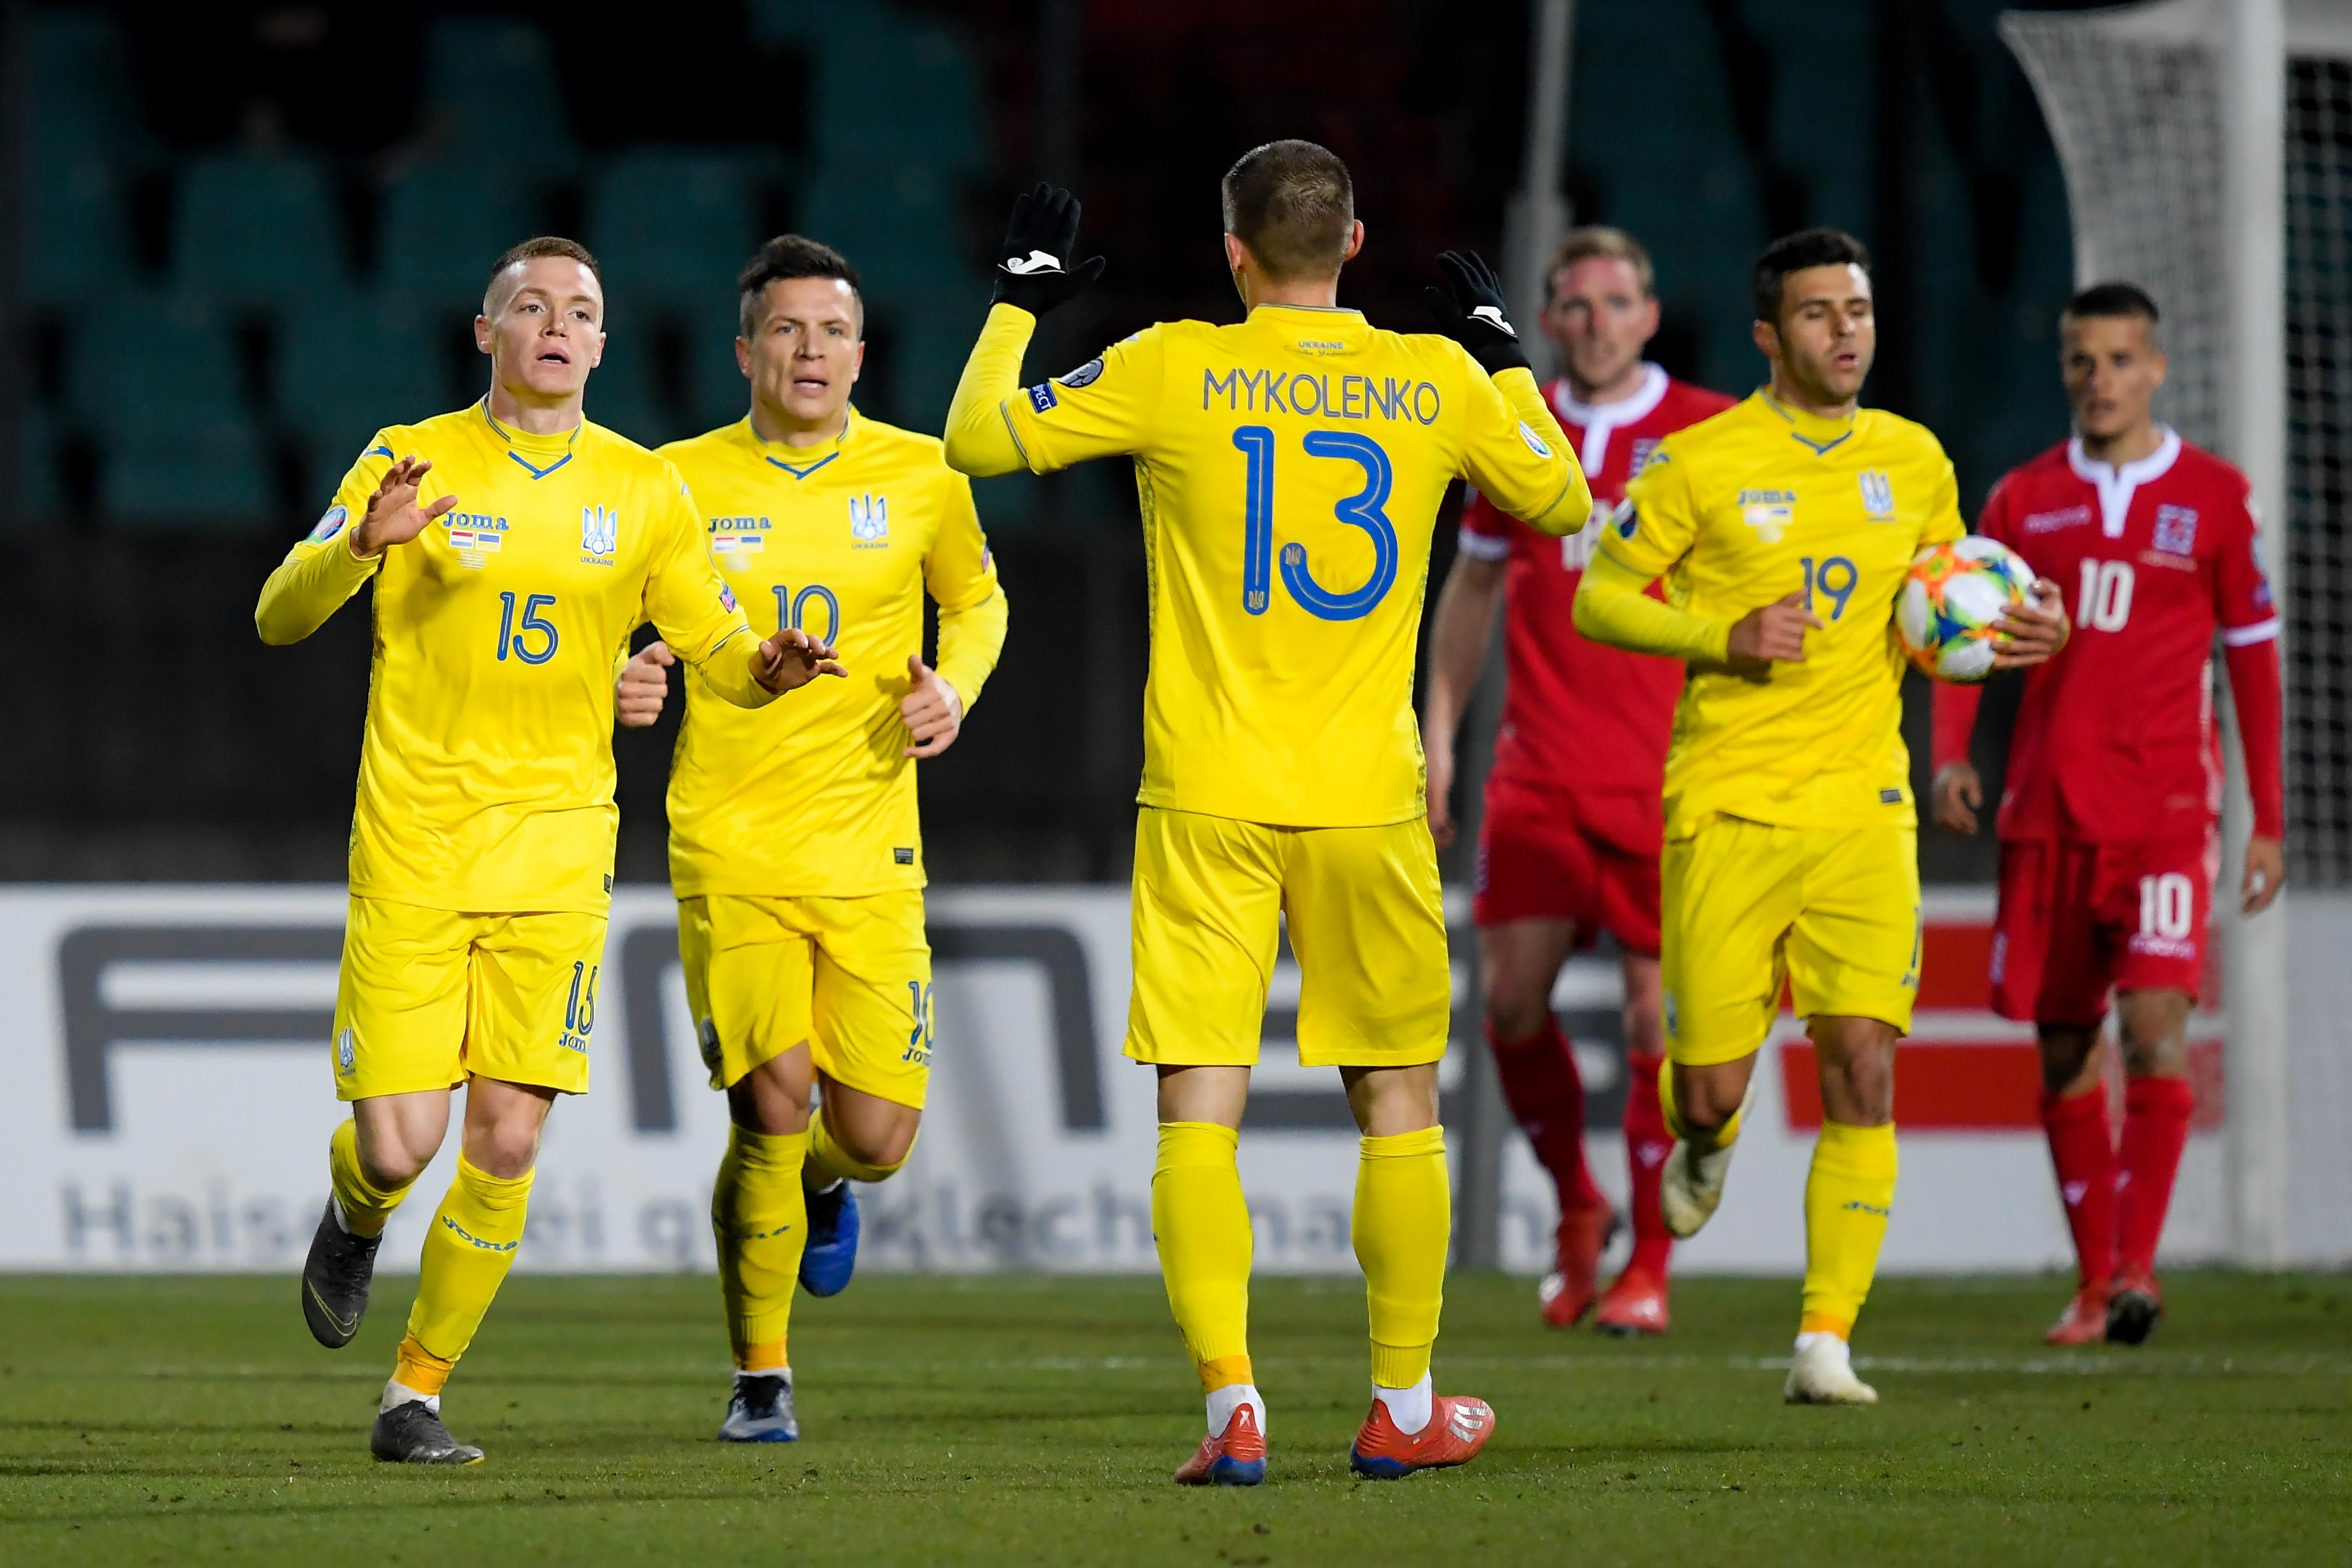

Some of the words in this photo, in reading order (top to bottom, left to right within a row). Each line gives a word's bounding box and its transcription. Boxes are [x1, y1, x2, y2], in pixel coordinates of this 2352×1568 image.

[1297, 340, 1344, 350] UKRAINE
[1031, 383, 1052, 410] PECT
[1203, 368, 1440, 426] MYKOLENKO
[443, 512, 509, 531] Joma
[708, 516, 772, 533] Joma
[1232, 425, 1399, 621] 13
[580, 555, 615, 567] UKRAINE
[1800, 557, 1858, 621] 19
[772, 585, 839, 648] 10
[2076, 557, 2135, 633] 10
[497, 591, 559, 665] 15
[2139, 872, 2193, 941] 10
